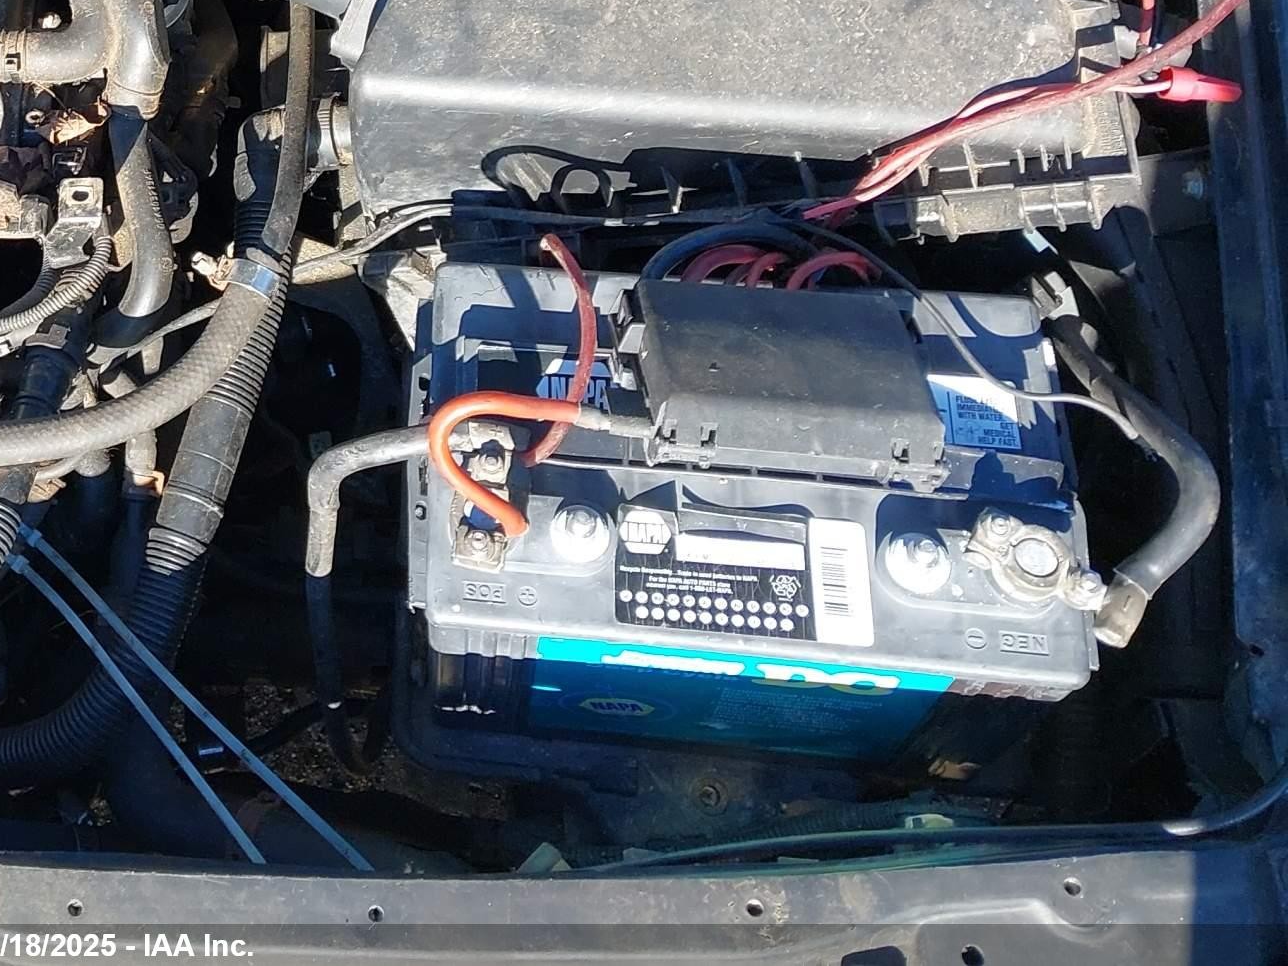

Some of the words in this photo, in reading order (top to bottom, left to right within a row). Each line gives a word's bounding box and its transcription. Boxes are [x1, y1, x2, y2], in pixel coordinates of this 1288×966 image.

[550, 375, 610, 411] NPA
[958, 412, 977, 420] WITH
[978, 435, 996, 445] HELP
[465, 582, 504, 599] POS
[1001, 633, 1048, 652] NEG
[589, 701, 645, 713] NAPA
